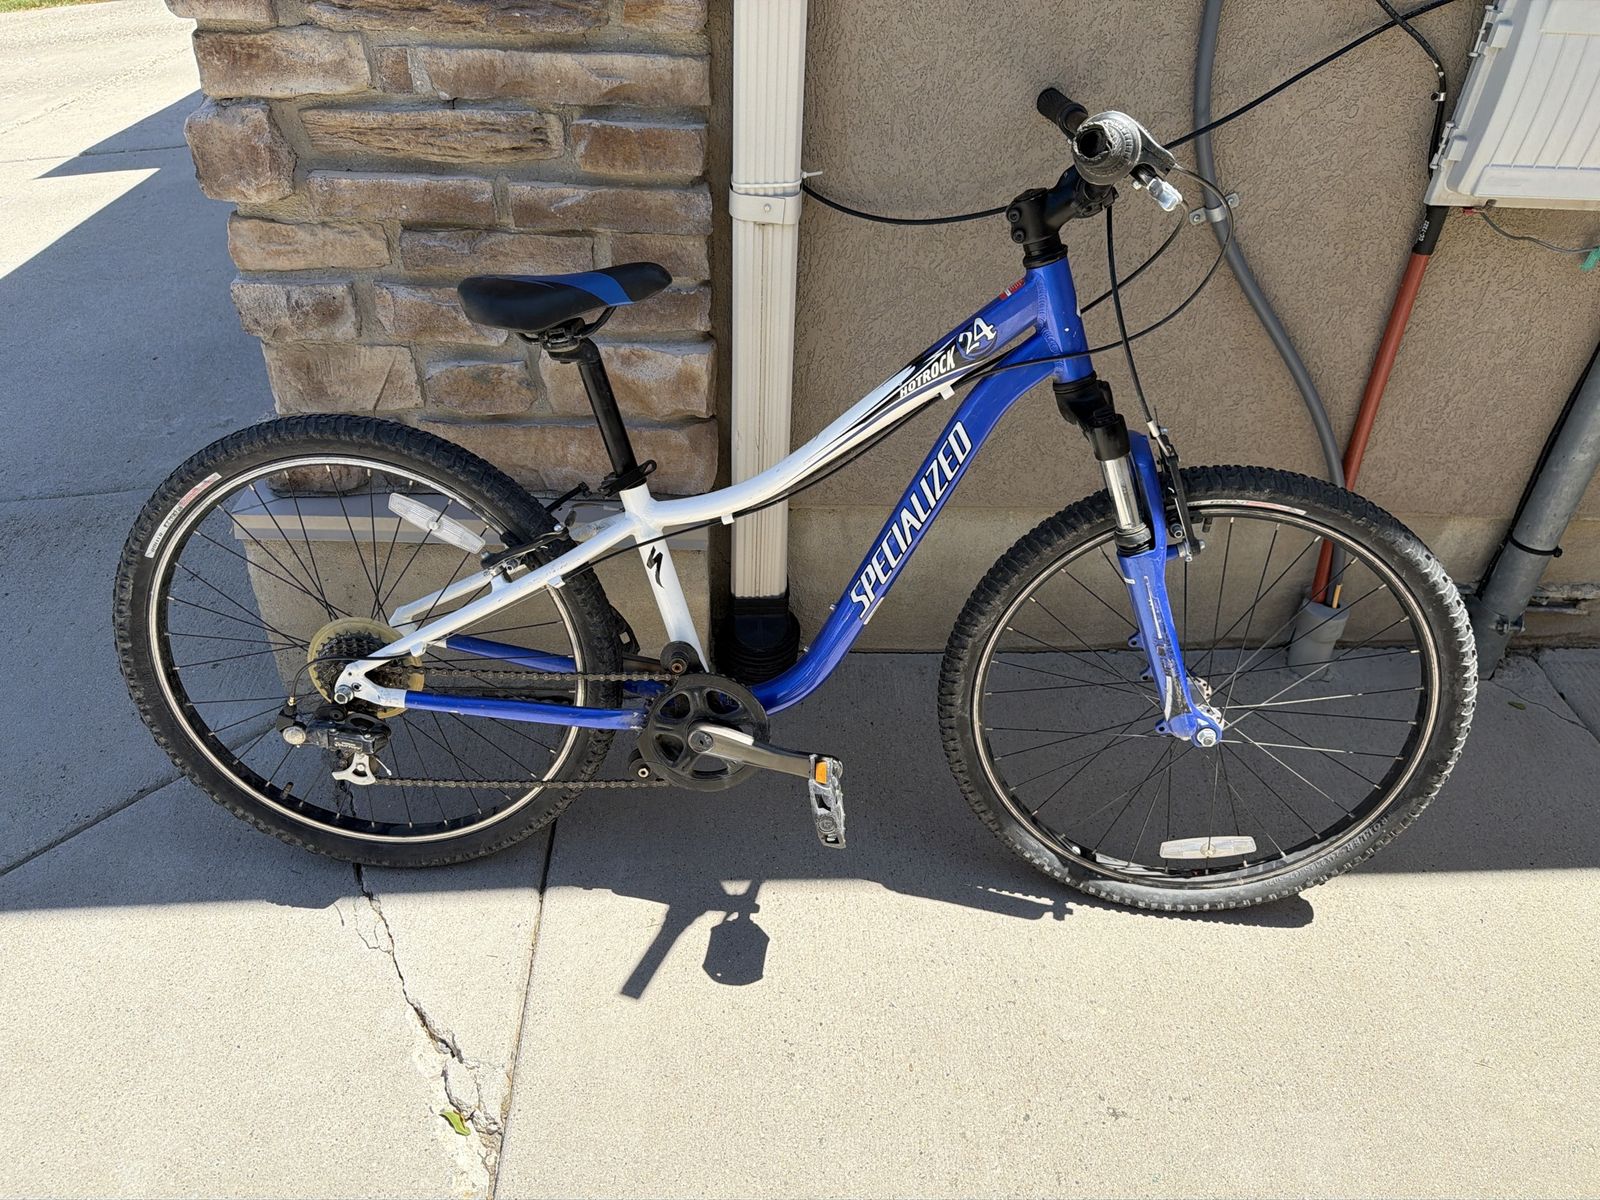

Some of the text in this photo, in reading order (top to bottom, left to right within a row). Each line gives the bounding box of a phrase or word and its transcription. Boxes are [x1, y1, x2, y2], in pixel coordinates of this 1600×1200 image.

[900, 317, 997, 397] HOTROCK 24
[850, 421, 972, 619] SPECIALIZED
